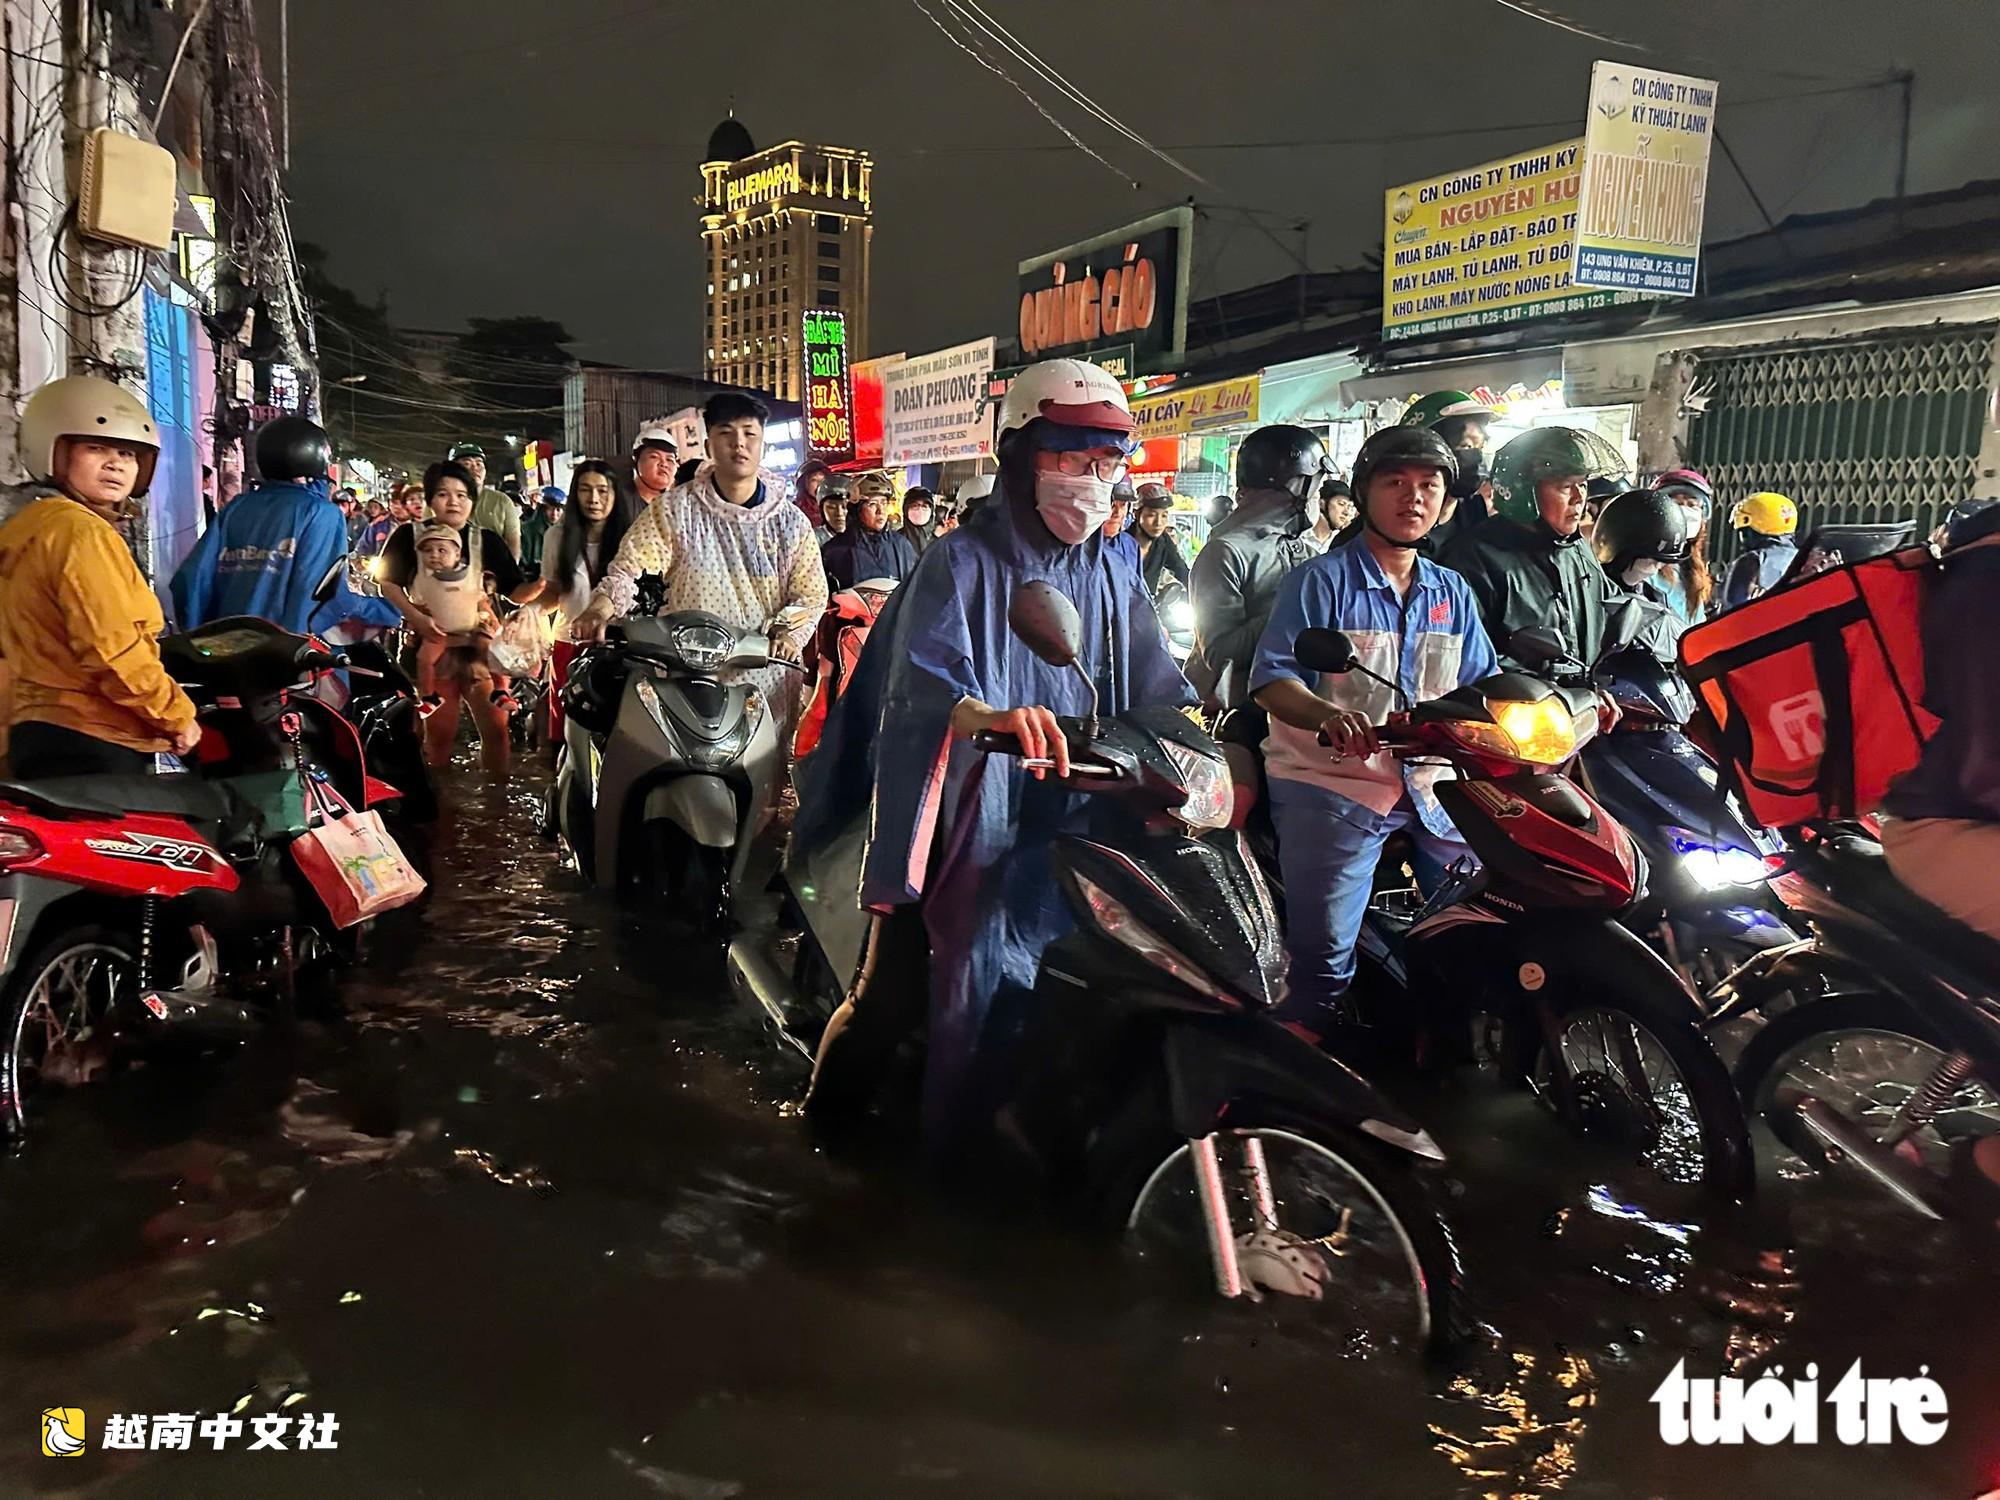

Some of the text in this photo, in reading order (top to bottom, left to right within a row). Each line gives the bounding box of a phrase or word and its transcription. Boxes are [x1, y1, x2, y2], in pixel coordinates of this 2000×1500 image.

[1632, 77, 1713, 108] CN CÔNG TY TNHH
[1648, 106, 1679, 132] THUẬT
[1680, 113, 1707, 135] LẠNH
[727, 162, 793, 201] BLUEMARQ
[1419, 186, 1438, 203] CN
[1443, 175, 1482, 198] CÔNG
[1486, 167, 1504, 186] TY
[1509, 157, 1550, 180] TNHH
[1394, 247, 1421, 267] MUA
[1425, 239, 1451, 260] BÁN
[1490, 225, 1517, 248] ĐẶT
[1527, 214, 1557, 238] BẢO
[1392, 273, 1418, 293] MÁY
[1463, 258, 1478, 279] TỦ
[1527, 244, 1544, 267] TỦ
[1581, 252, 1596, 266] 143
[1392, 300, 1413, 317] KHO
[1450, 286, 1475, 307] MÁY
[1515, 276, 1550, 296] NÓNG
[1627, 272, 1640, 285] 123
[1677, 278, 1690, 290] 123
[1019, 243, 1157, 355] QUẢNG CÁO
[1587, 294, 1605, 309] 123
[806, 313, 844, 345] BÁNH
[1155, 399, 1185, 421] CÂY
[811, 412, 848, 446] NỘI
[1483, 891, 1525, 912] HONDA
